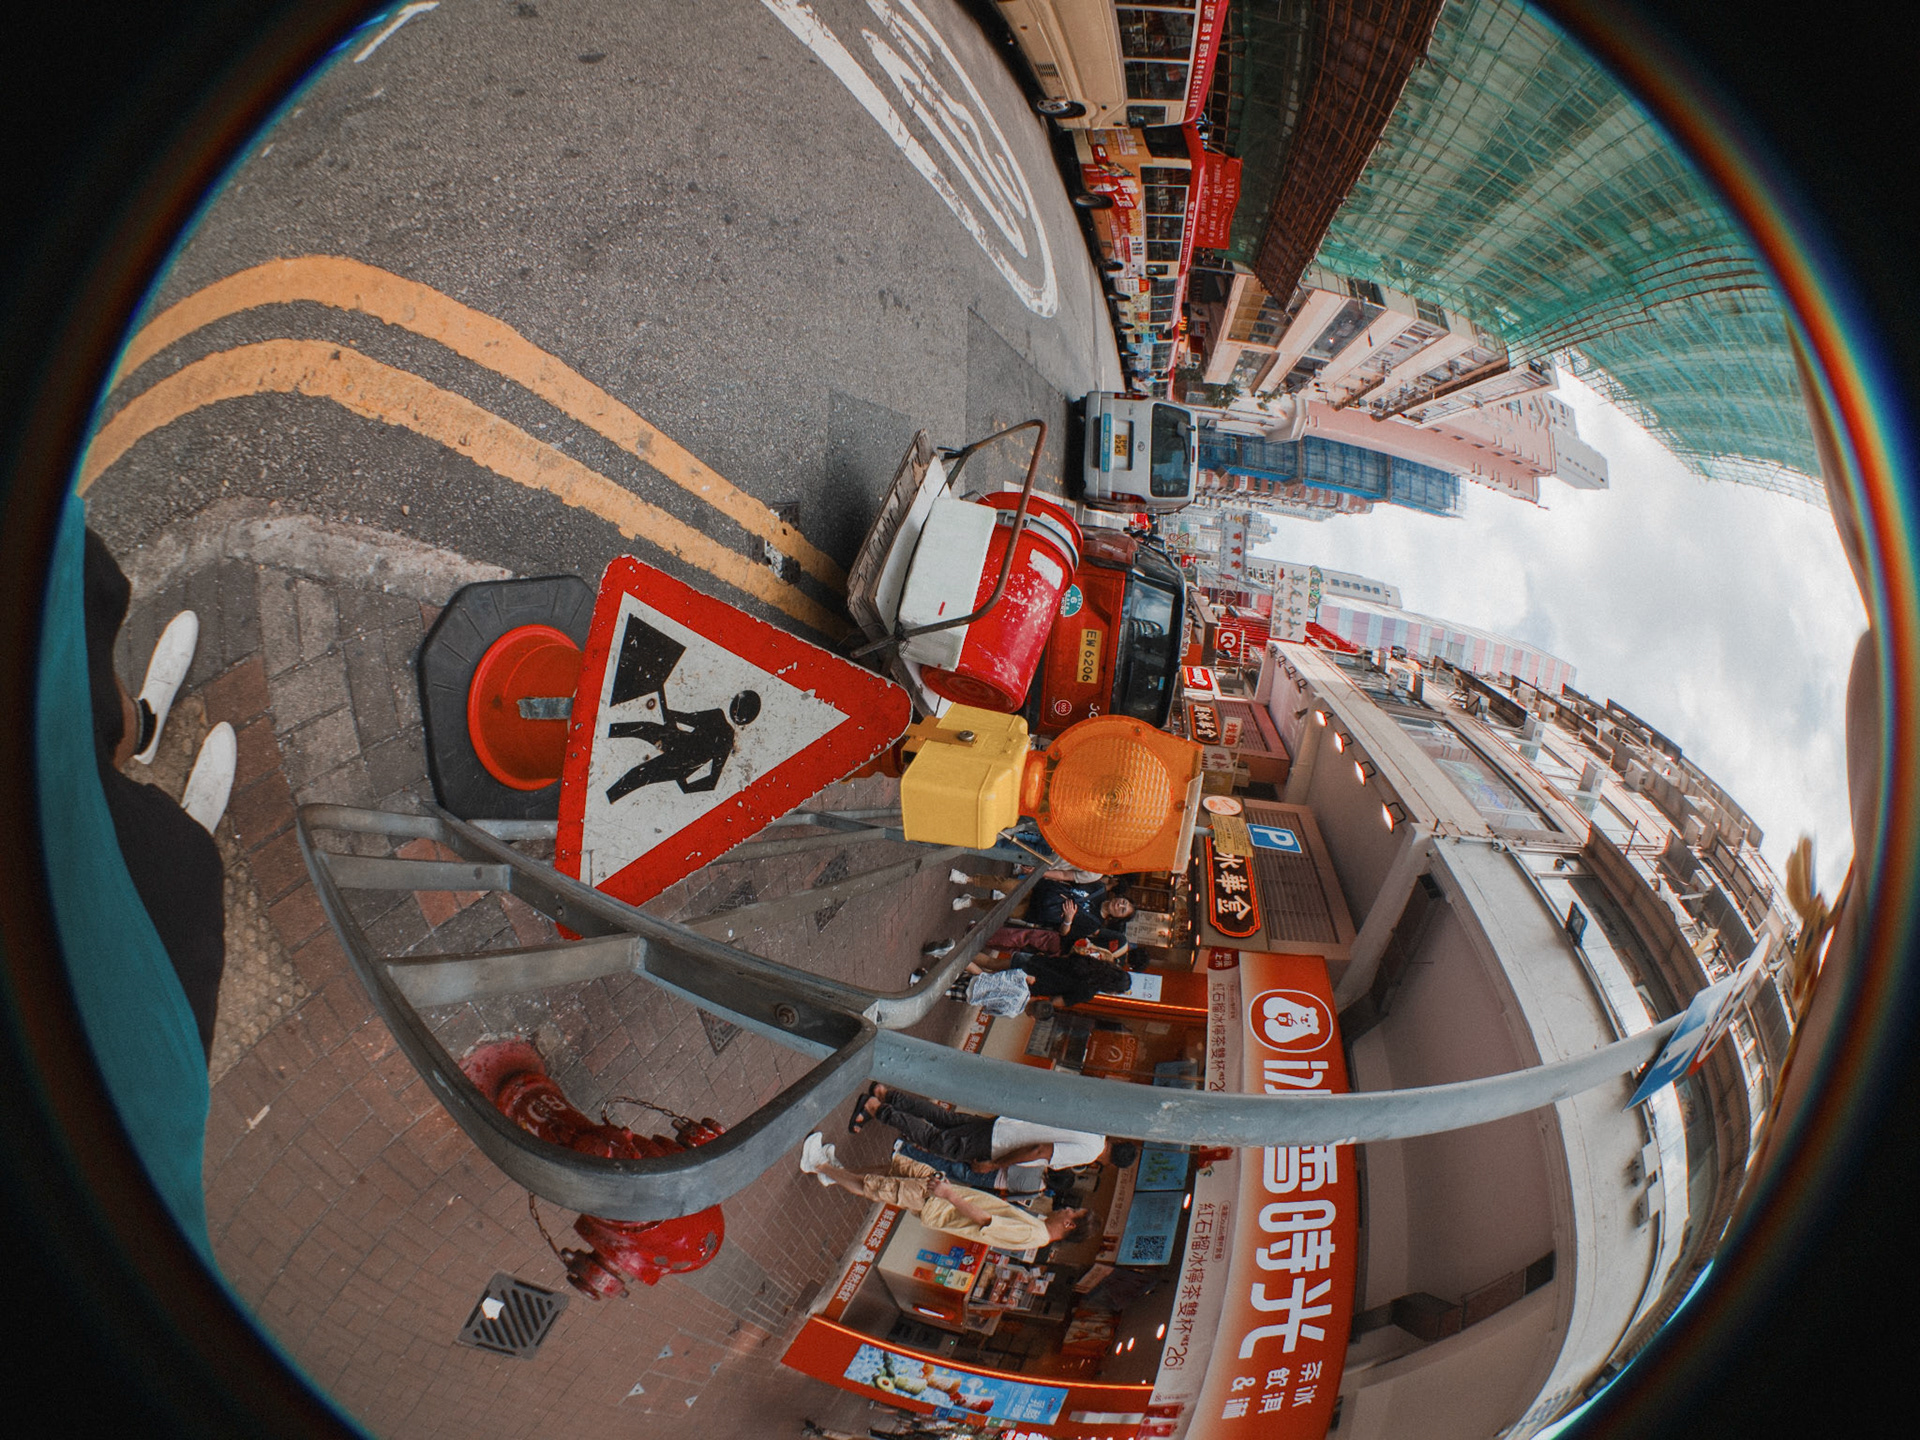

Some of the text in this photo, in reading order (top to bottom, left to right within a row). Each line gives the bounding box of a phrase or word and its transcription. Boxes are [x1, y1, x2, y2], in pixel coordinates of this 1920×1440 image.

[1070, 596, 1078, 604] 6
[1181, 622, 1191, 656] TAXI
[1082, 630, 1097, 682] EW 6206
[1253, 827, 1294, 846] P
[1122, 1037, 1136, 1071] COFFE
[1164, 1346, 1188, 1367] 26
